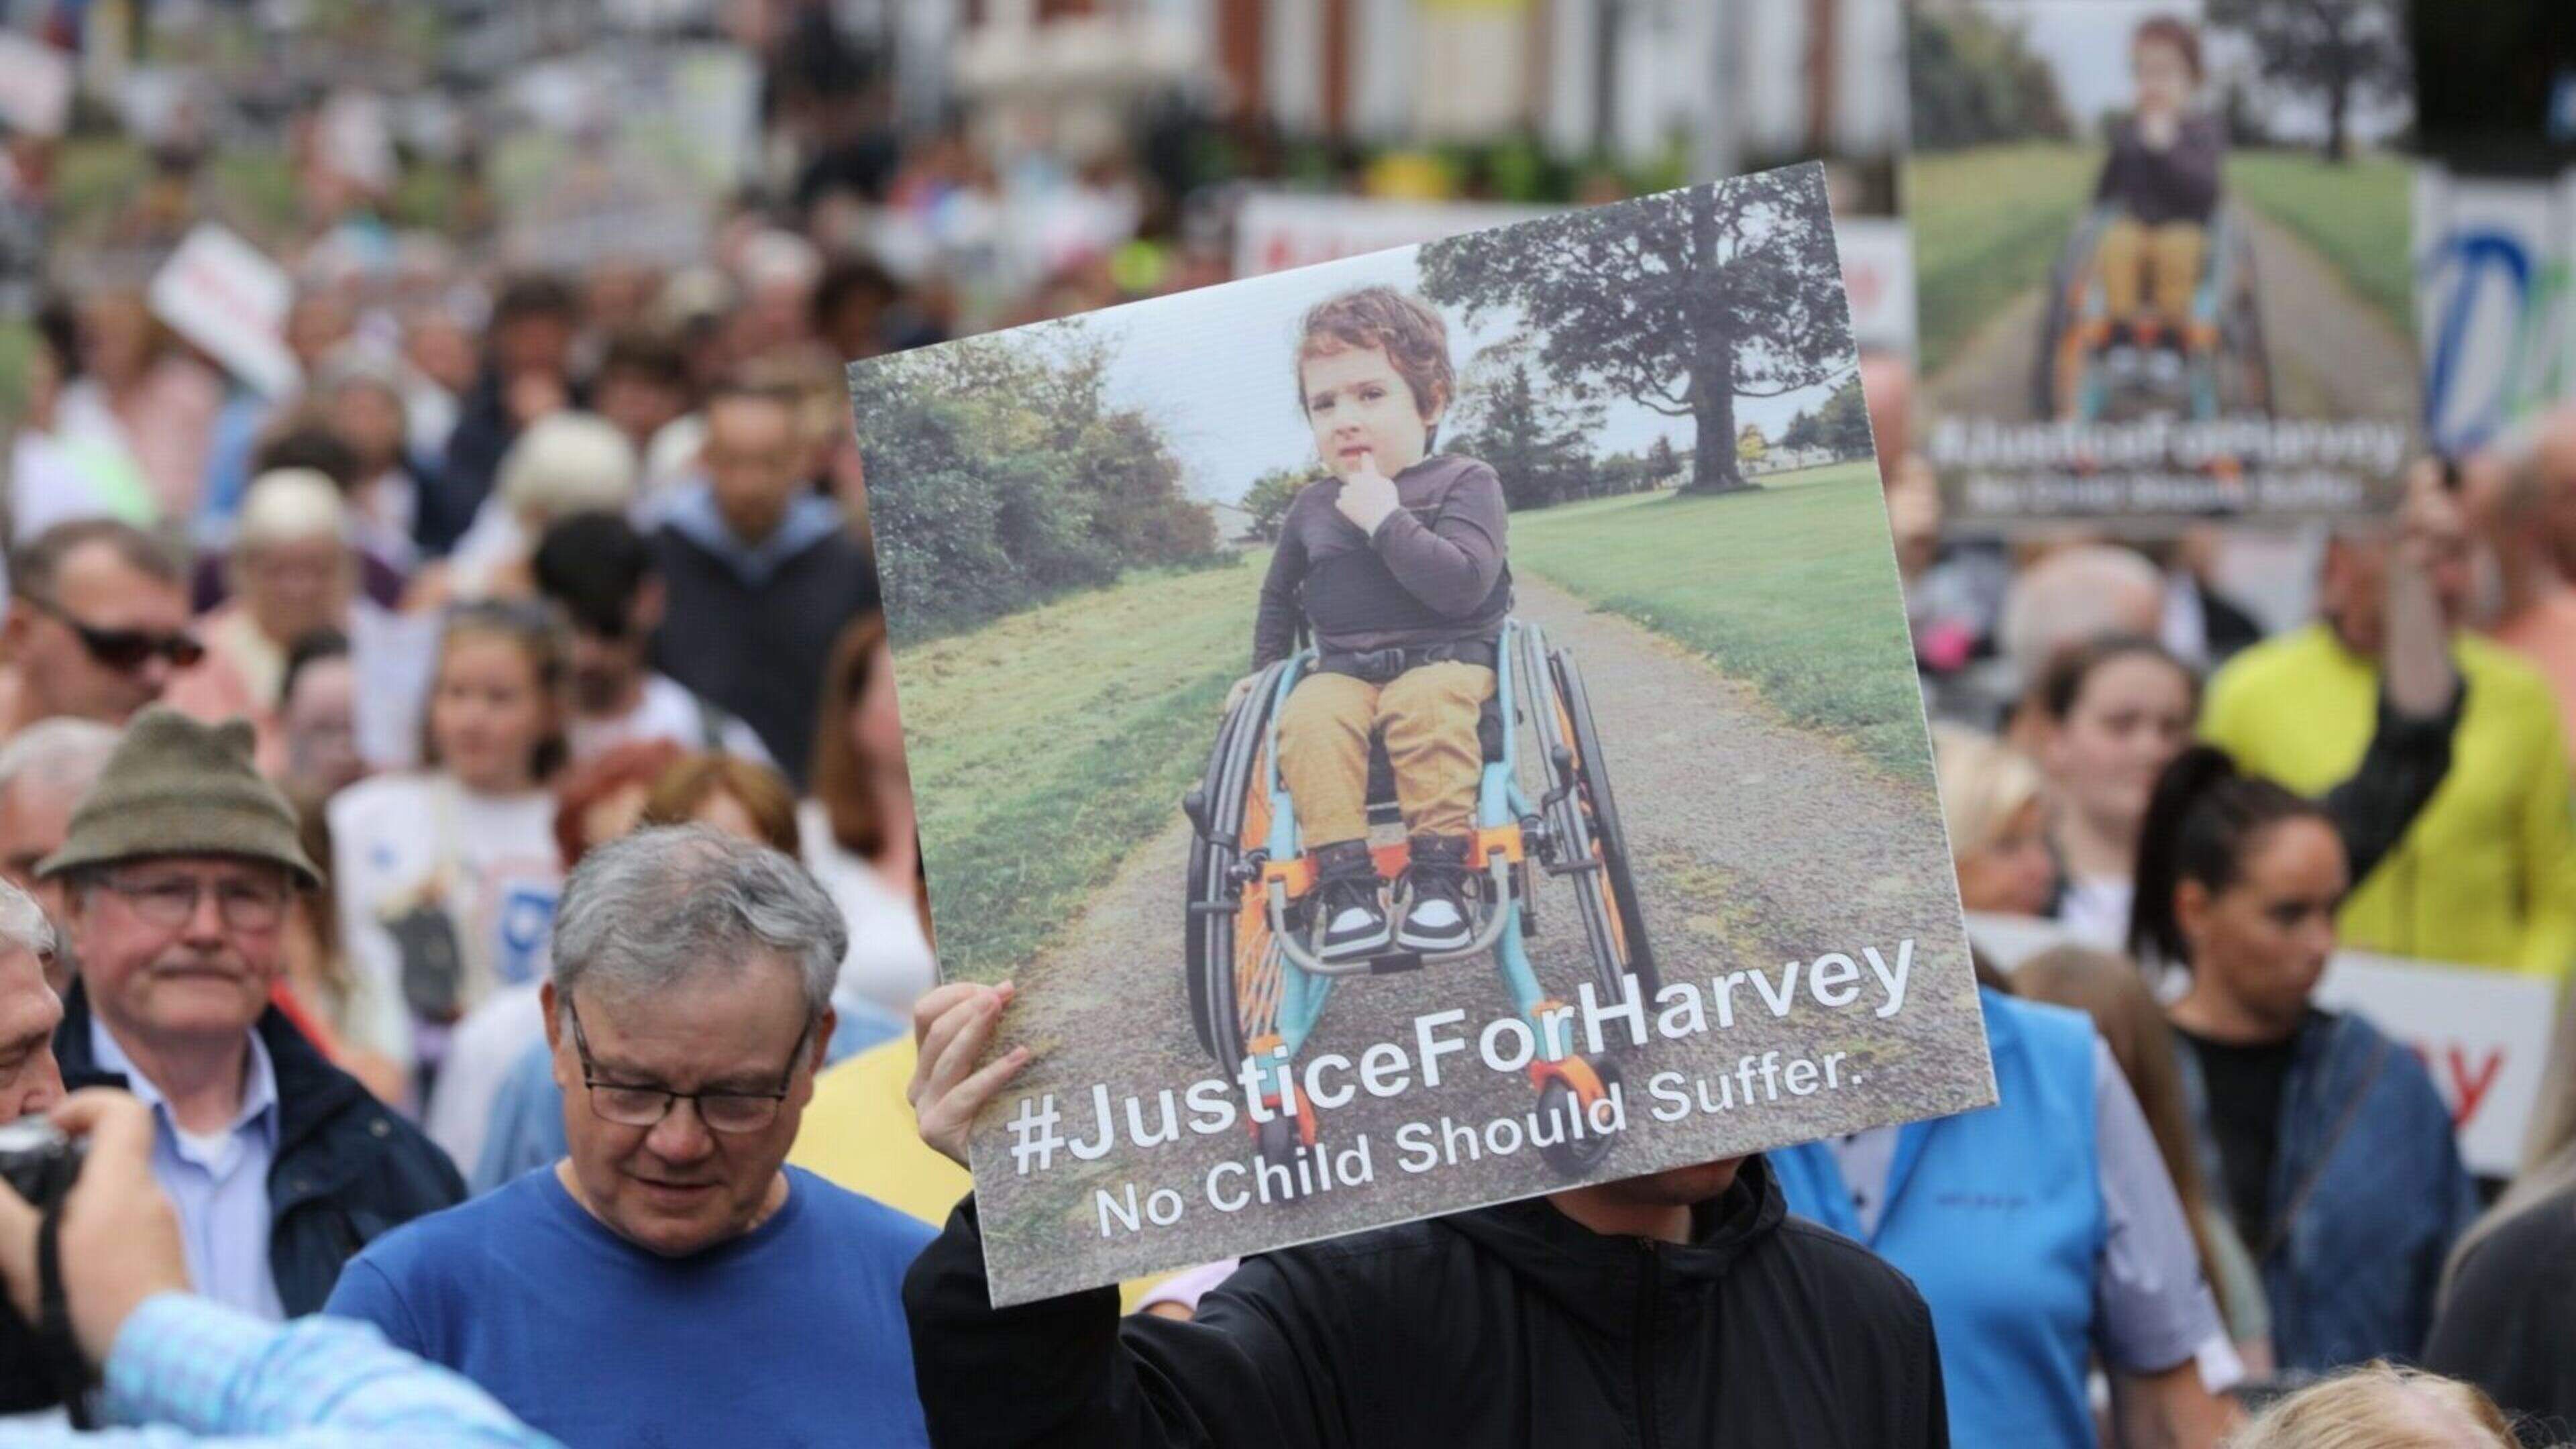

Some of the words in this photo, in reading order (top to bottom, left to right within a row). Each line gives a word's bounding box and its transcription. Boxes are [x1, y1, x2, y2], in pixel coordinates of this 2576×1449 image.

[1008, 939, 1914, 1175] #JusticeForHarvey
[1095, 1183, 1183, 1238] No
[1206, 1134, 1374, 1212] Child
[1396, 1083, 1627, 1173] Should
[1648, 1051, 1863, 1122] Suffer.
